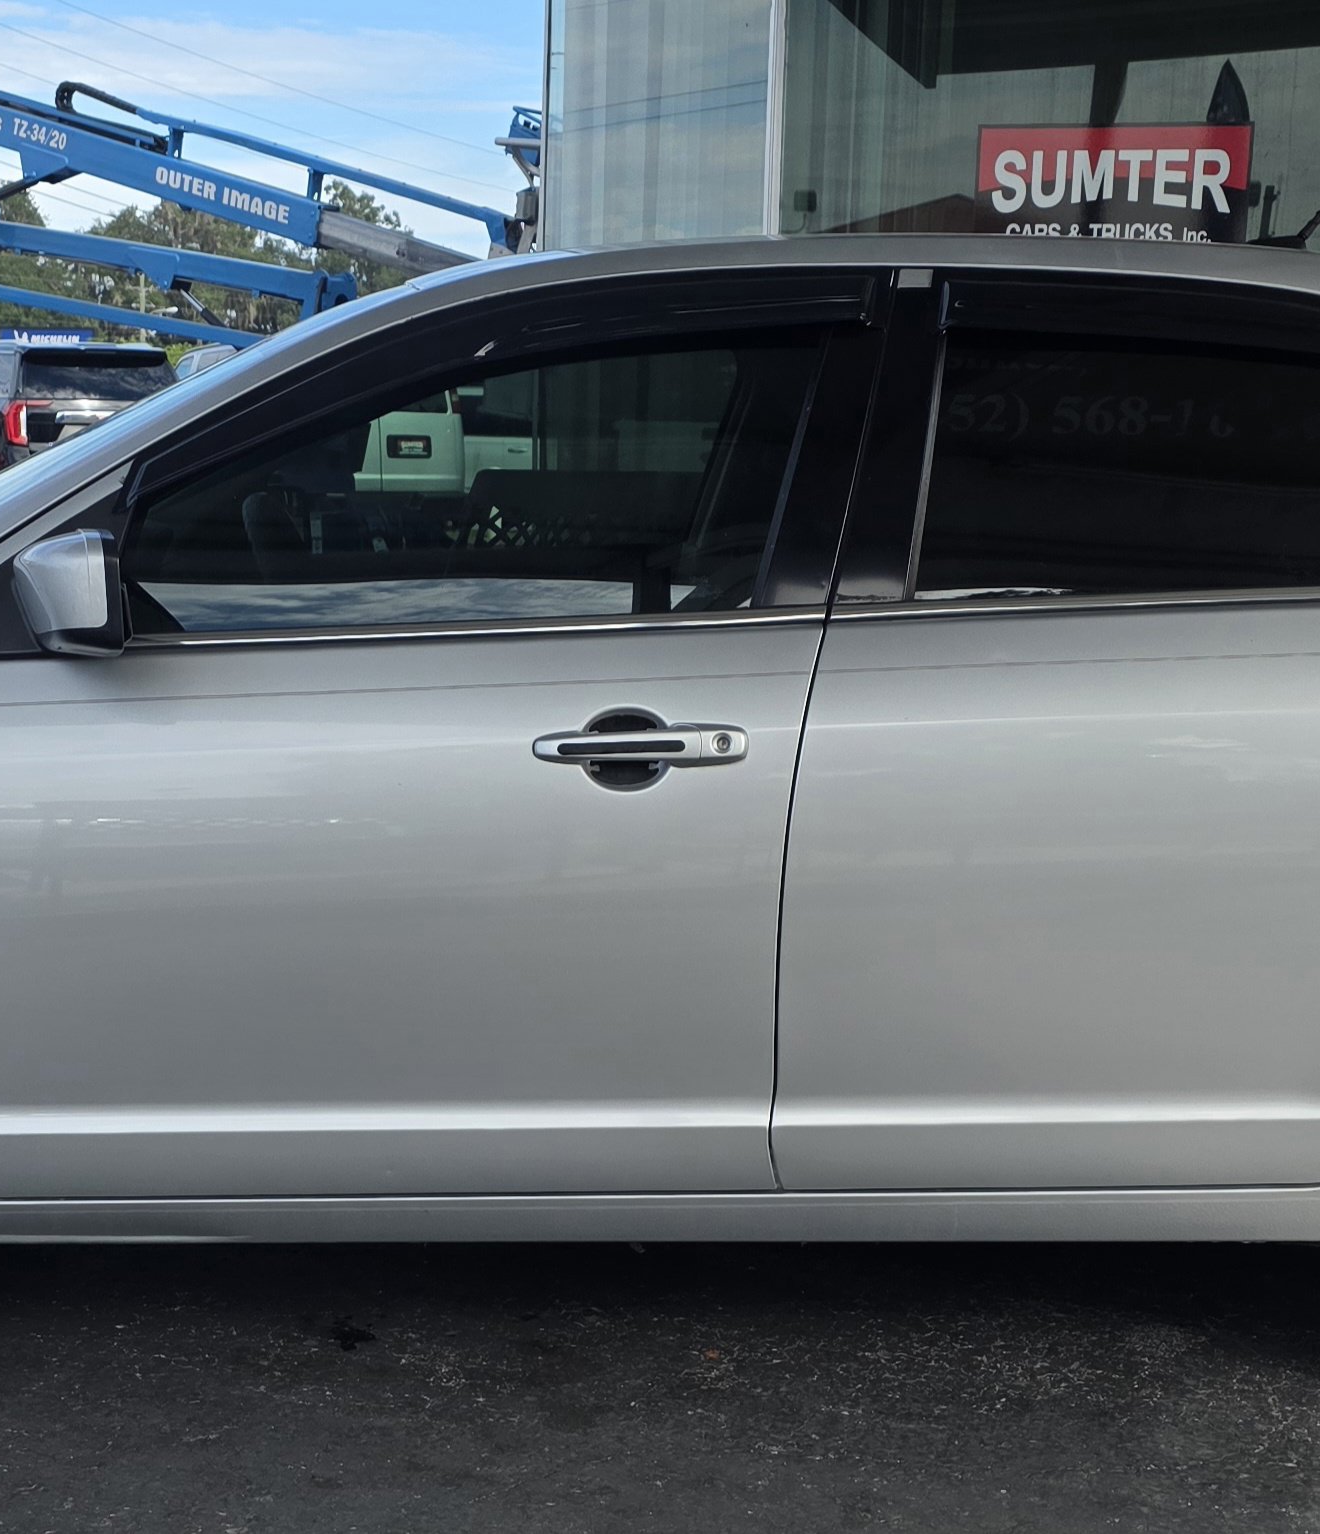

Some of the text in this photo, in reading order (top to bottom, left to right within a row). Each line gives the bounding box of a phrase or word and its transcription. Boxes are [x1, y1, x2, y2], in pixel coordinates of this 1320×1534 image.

[13, 118, 67, 150] TZ-34/20
[155, 166, 290, 225] OUTER IMAGE
[991, 148, 1231, 214] SUMTER
